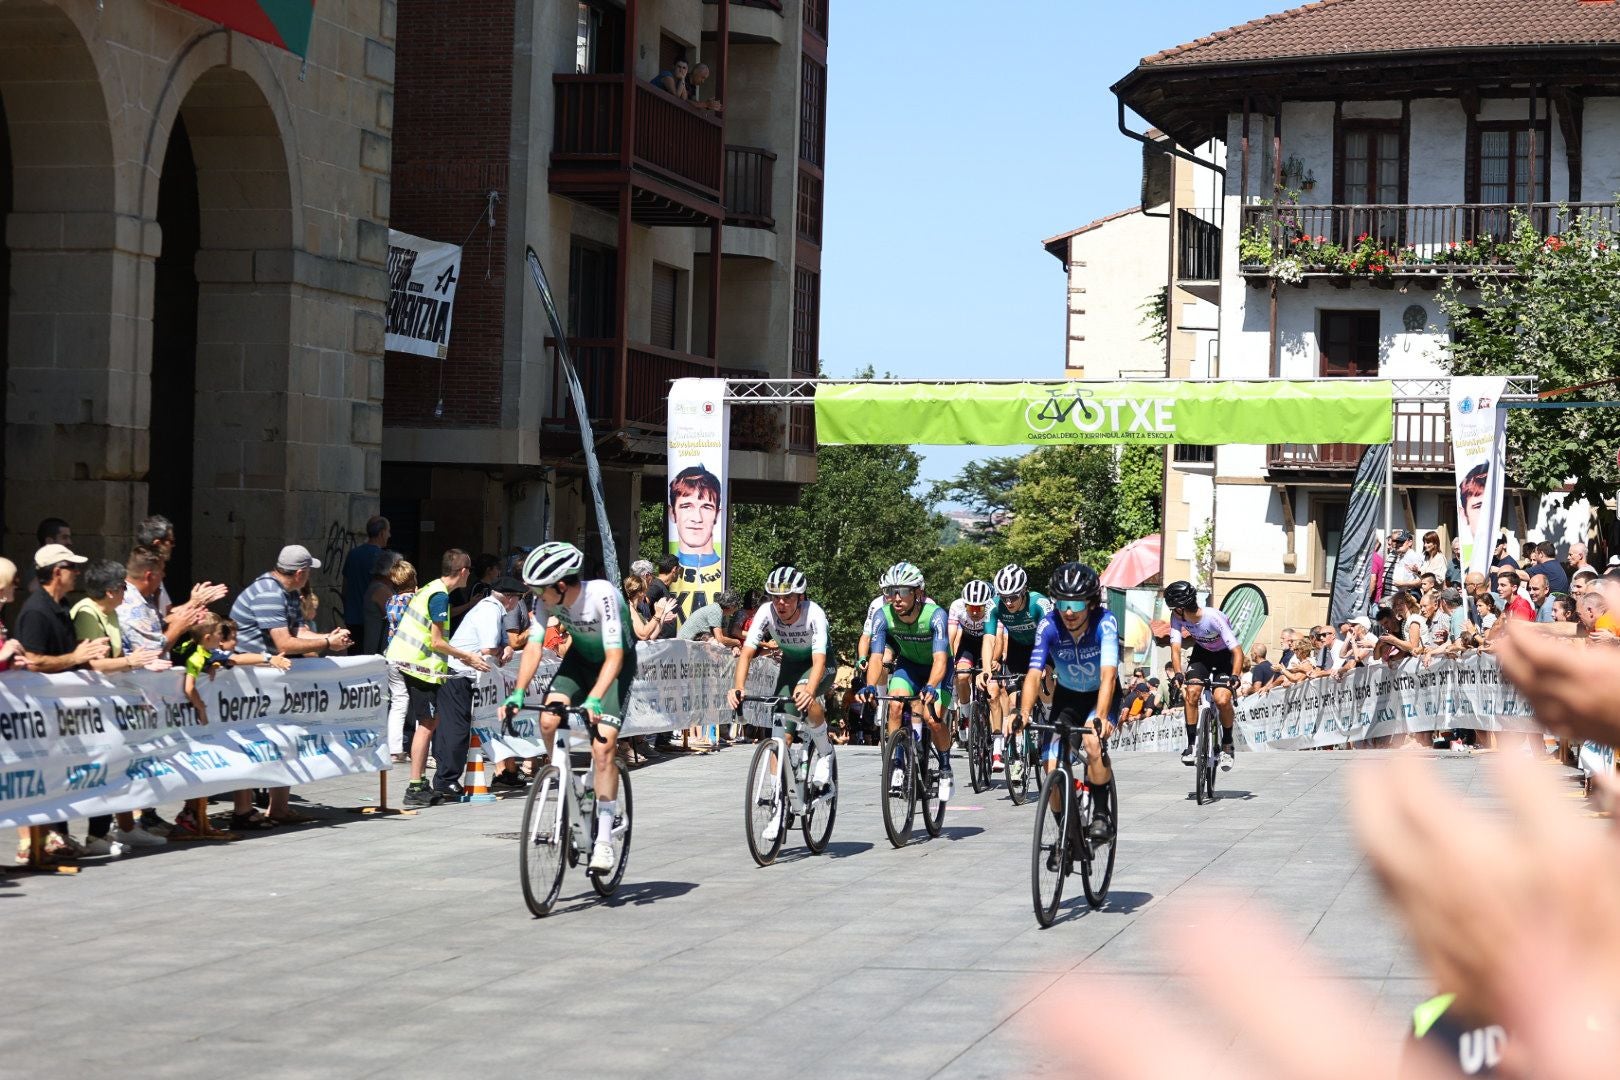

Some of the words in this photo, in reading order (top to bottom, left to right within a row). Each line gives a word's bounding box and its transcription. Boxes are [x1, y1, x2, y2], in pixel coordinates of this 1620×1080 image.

[1072, 400, 1176, 432] OTXE
[1027, 432, 1078, 440] OARSOALDEKO
[1080, 431, 1145, 439] TXIRRINDULARITZA
[54, 699, 105, 736] berria
[162, 696, 200, 728] berr
[218, 687, 272, 722] berria
[279, 683, 329, 714] berria
[338, 678, 382, 710] berria
[473, 678, 498, 708] erria
[0, 767, 46, 800] HITZA
[66, 762, 108, 791] HITZA
[186, 750, 231, 771] HITZA
